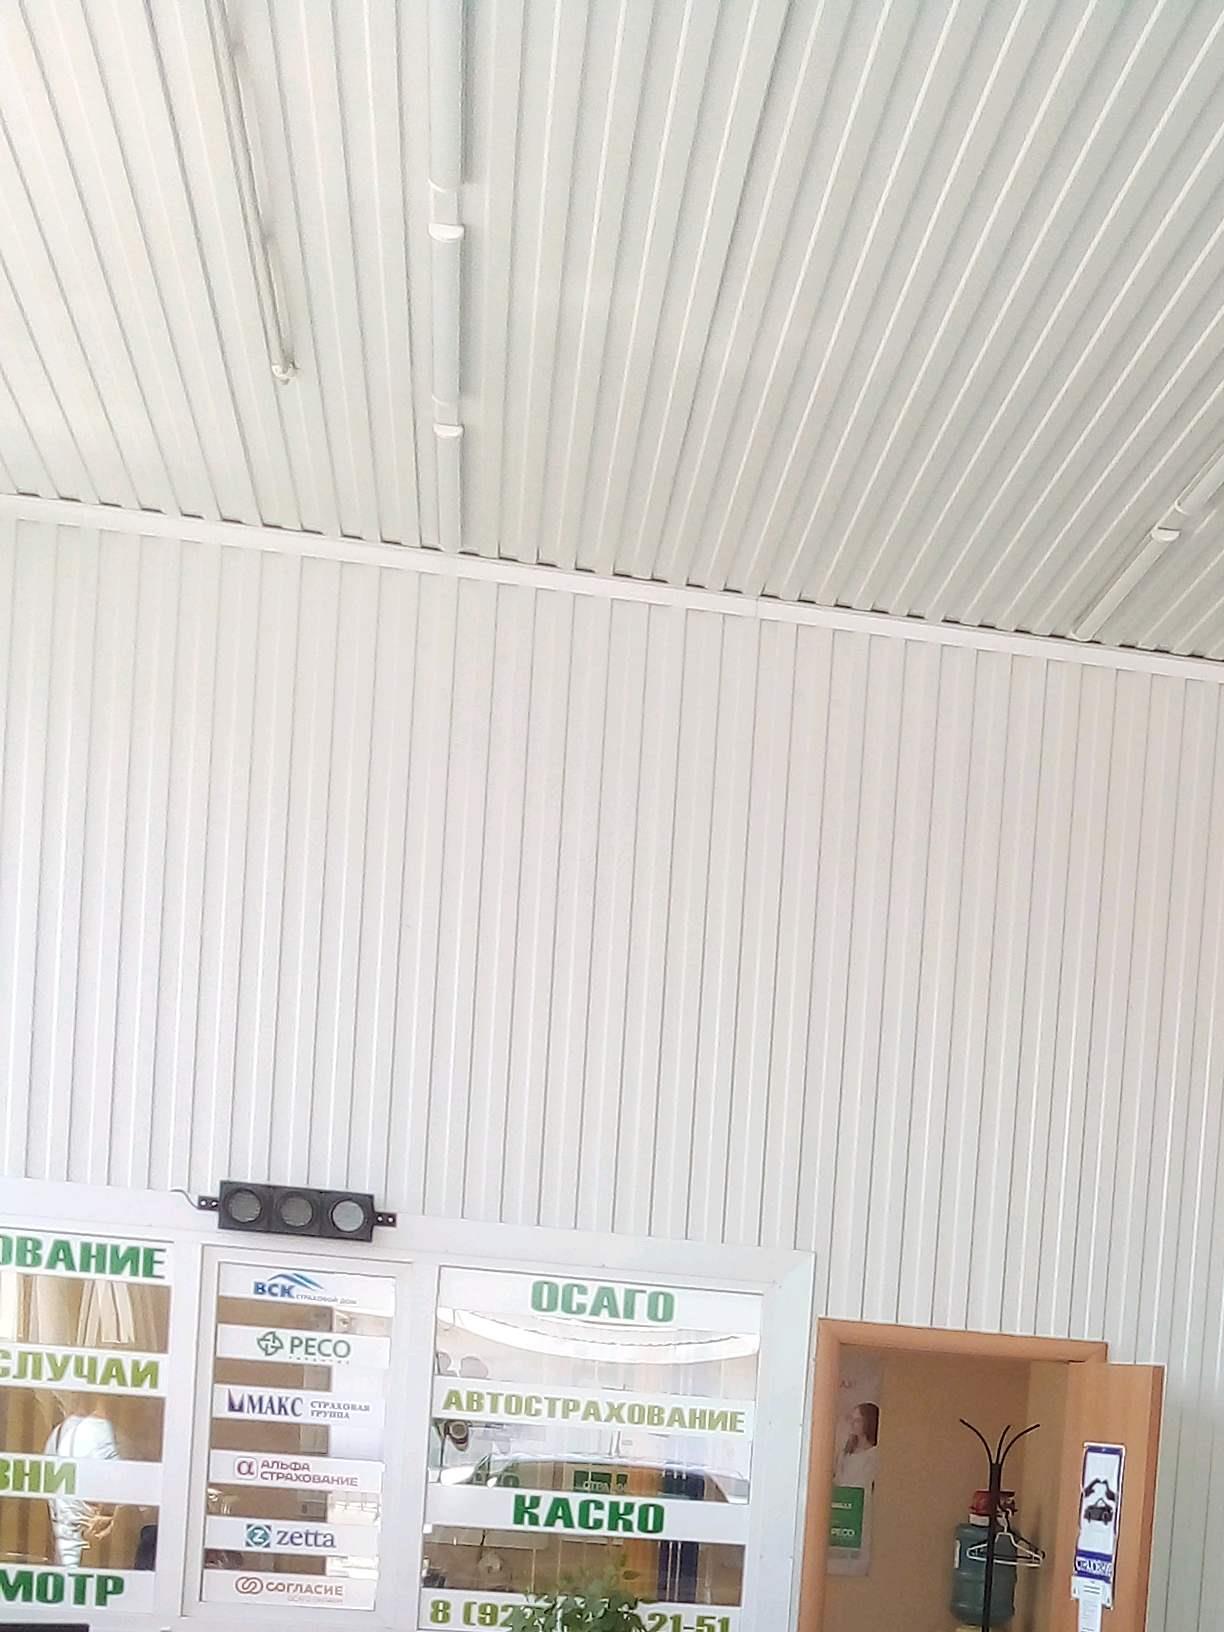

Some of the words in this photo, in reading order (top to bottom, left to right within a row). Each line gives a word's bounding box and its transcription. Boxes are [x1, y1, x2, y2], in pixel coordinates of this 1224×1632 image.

[253, 1281, 296, 1299] ВСК
[531, 1279, 675, 1323] ОСАГО
[290, 1336, 351, 1358] РЕСО
[246, 1393, 304, 1417] МАКС
[441, 1389, 745, 1434] АВТОСТРАХОВАНИЕ
[260, 1459, 311, 1472] АЛЬФА
[260, 1471, 359, 1487] СТРАХОВАНИЕ
[512, 1494, 665, 1534] КАСКО
[276, 1528, 337, 1549] zetta
[265, 1581, 344, 1597] СОГЛАСИЕ
[430, 1599, 451, 1624] 8
